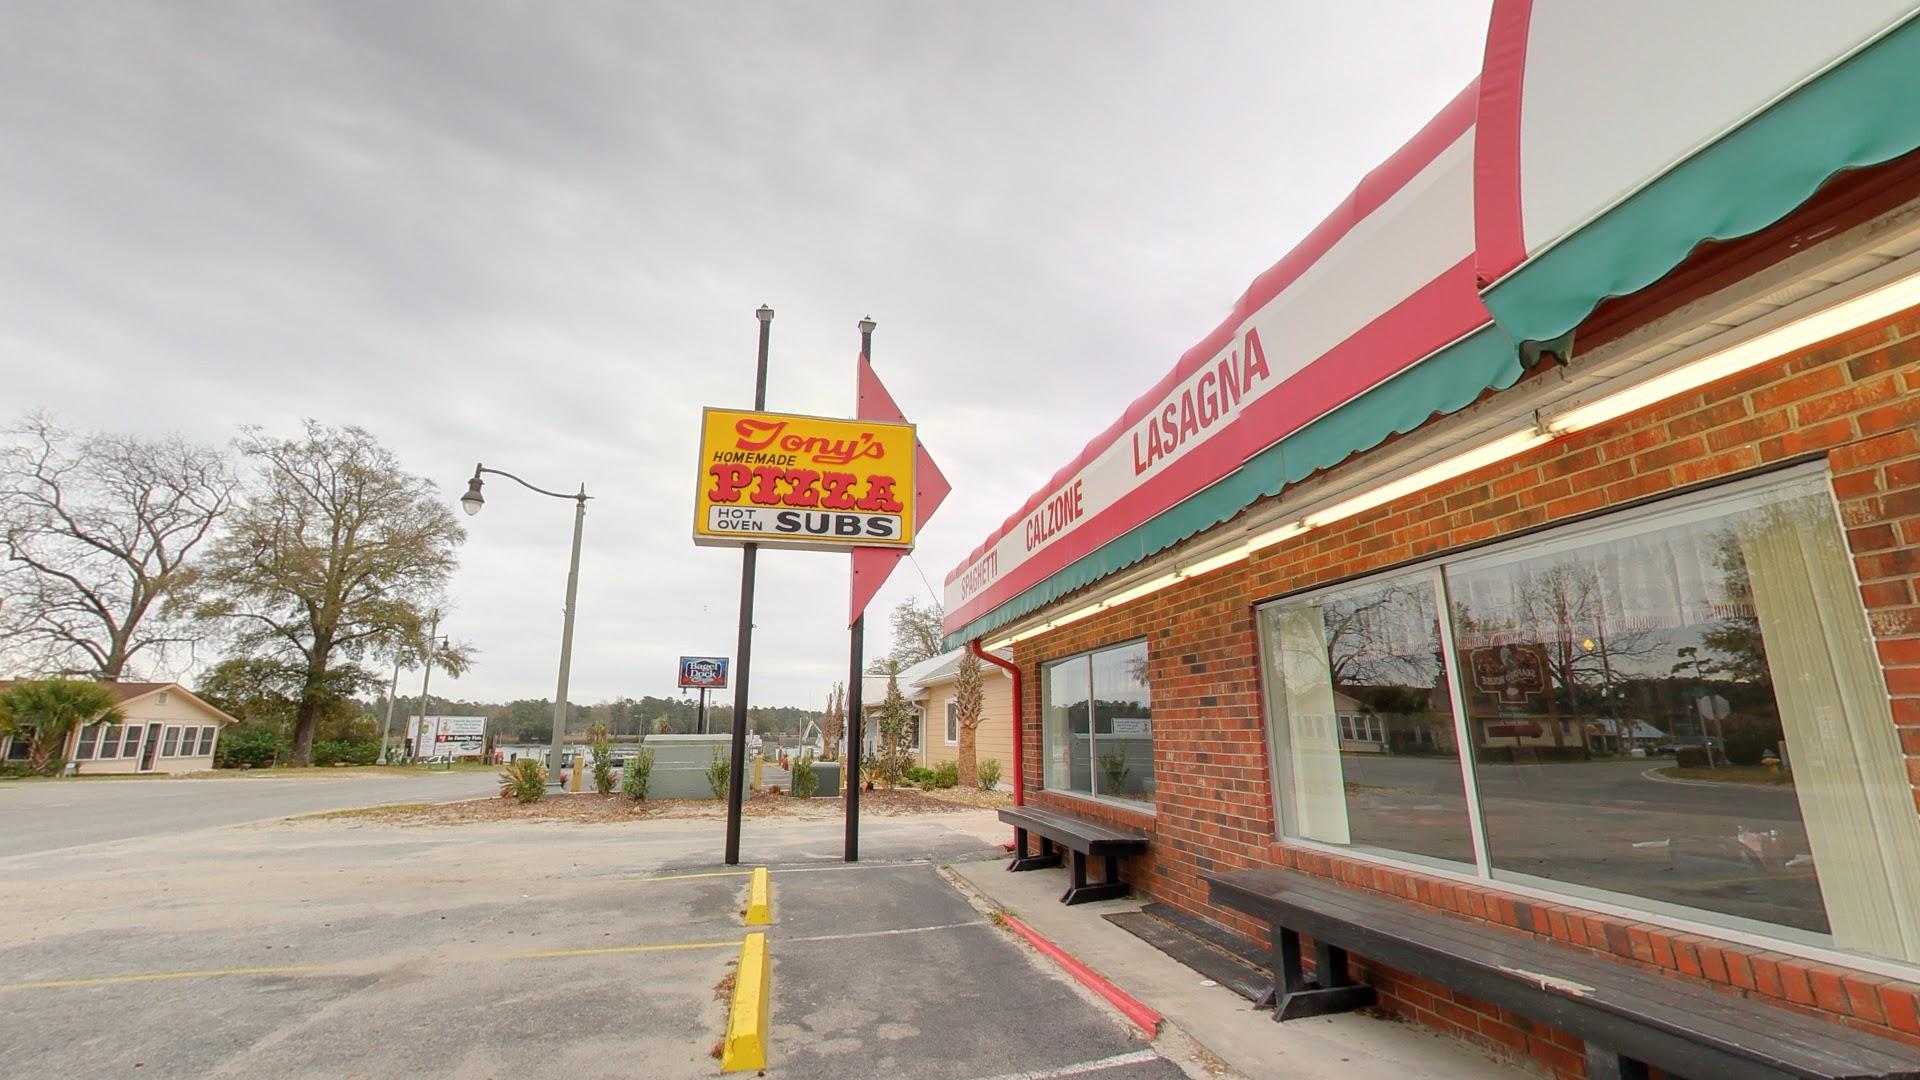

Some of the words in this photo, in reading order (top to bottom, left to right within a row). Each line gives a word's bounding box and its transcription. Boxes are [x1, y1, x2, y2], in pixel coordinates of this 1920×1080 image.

[1132, 326, 1270, 477] LASAGNA
[735, 418, 885, 465] Tony's
[712, 451, 797, 466] HOMEMADE
[708, 464, 904, 513] PIZZA
[717, 519, 763, 531] OVEN
[718, 508, 757, 519] HOT
[775, 511, 894, 537] SUBS
[1025, 479, 1084, 552] CALZONE
[961, 548, 999, 600] SPAGHETTI
[690, 661, 718, 671] Bagel
[690, 670, 716, 679] Dock
